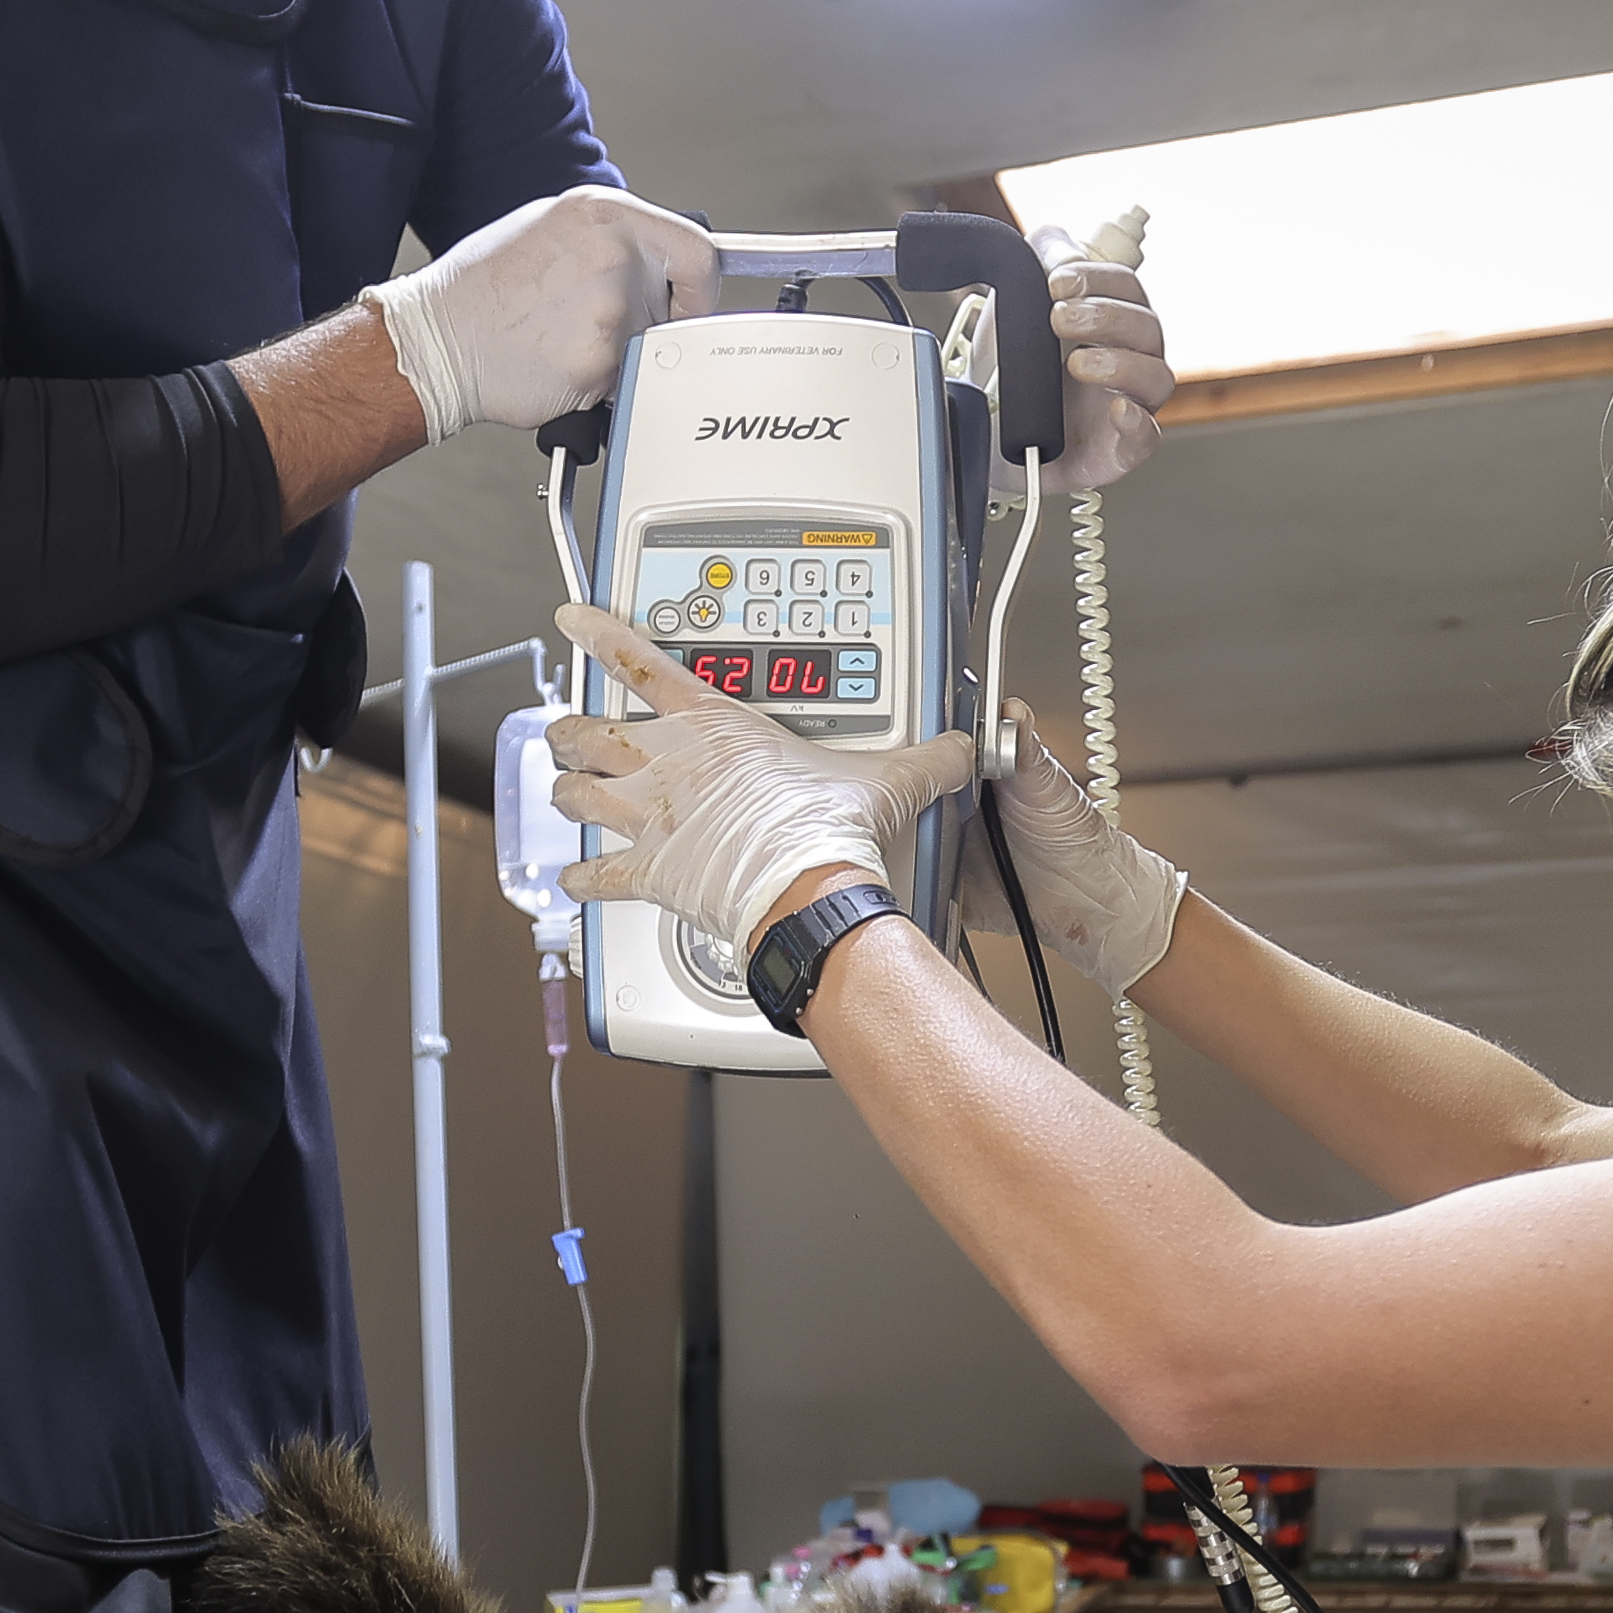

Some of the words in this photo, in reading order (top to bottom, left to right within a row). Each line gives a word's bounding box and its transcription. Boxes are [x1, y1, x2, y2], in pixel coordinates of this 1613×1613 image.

[709, 346, 736, 356] ONLY
[738, 346, 758, 356] USE
[759, 346, 820, 356] VETERINARY
[821, 346, 843, 356] FOR
[694, 415, 851, 441] XPRIME
[806, 533, 862, 544] WARNING
[759, 569, 771, 586] 6
[804, 570, 816, 587] 5
[849, 570, 861, 587] 4
[756, 610, 767, 627] 3
[802, 611, 813, 627] 2
[850, 611, 858, 627] 1
[768, 657, 826, 694] 70
[798, 719, 826, 728] READY
